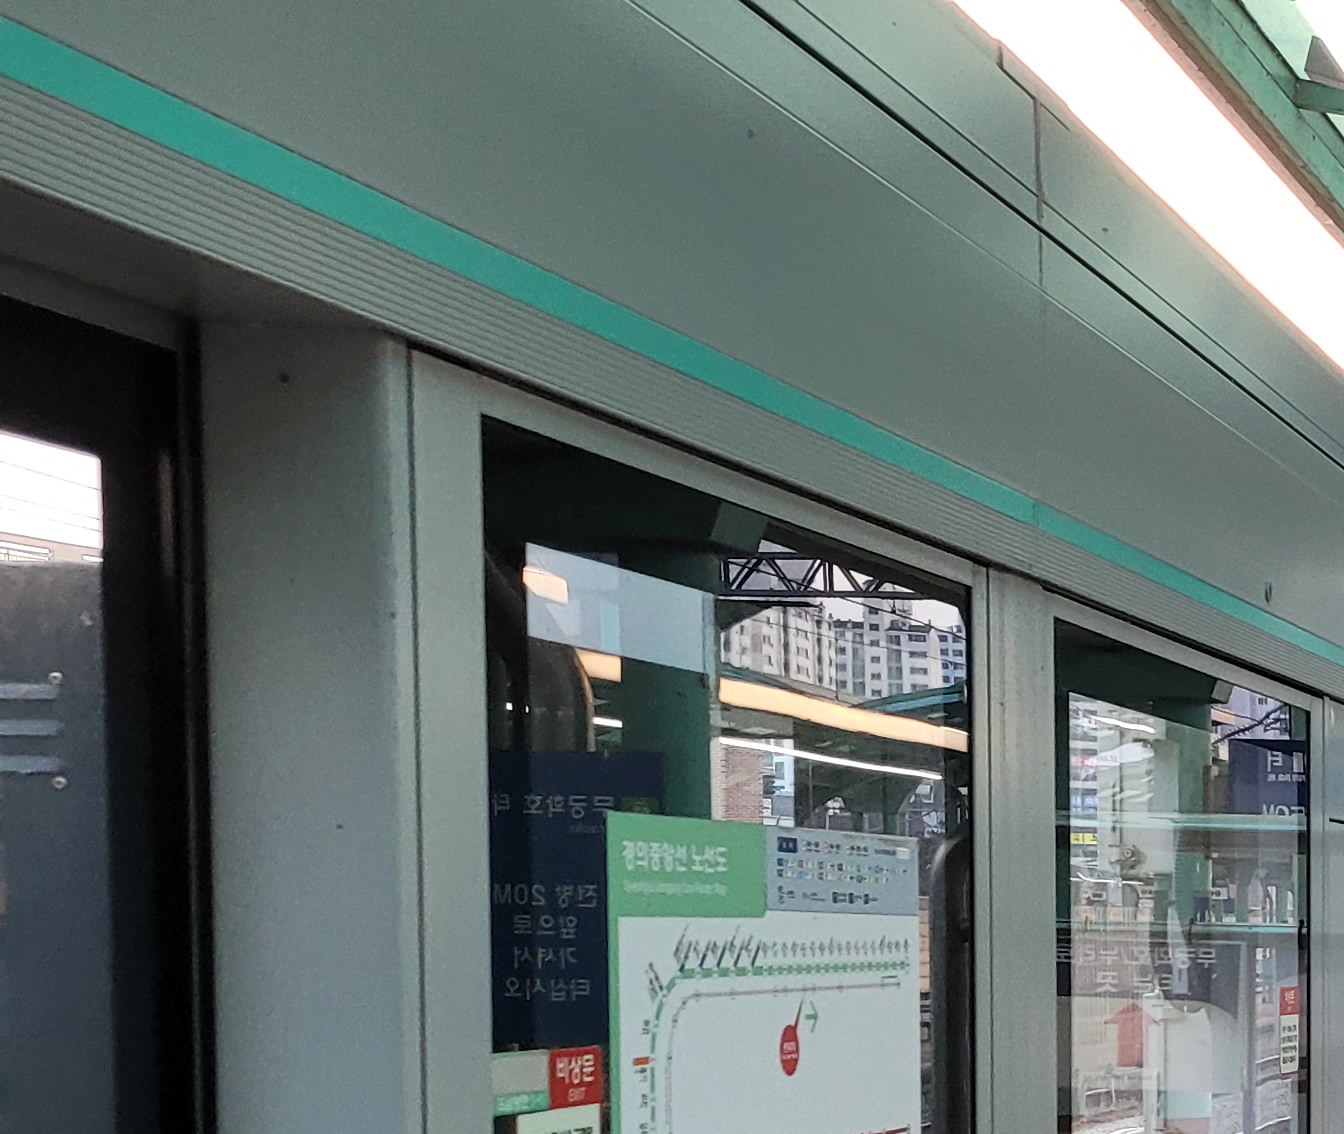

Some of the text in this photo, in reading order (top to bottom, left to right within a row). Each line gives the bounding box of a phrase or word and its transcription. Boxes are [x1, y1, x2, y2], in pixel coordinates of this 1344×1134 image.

[622, 841, 728, 873] 경의중앙선 노선도
[556, 1053, 595, 1085] 비상문
